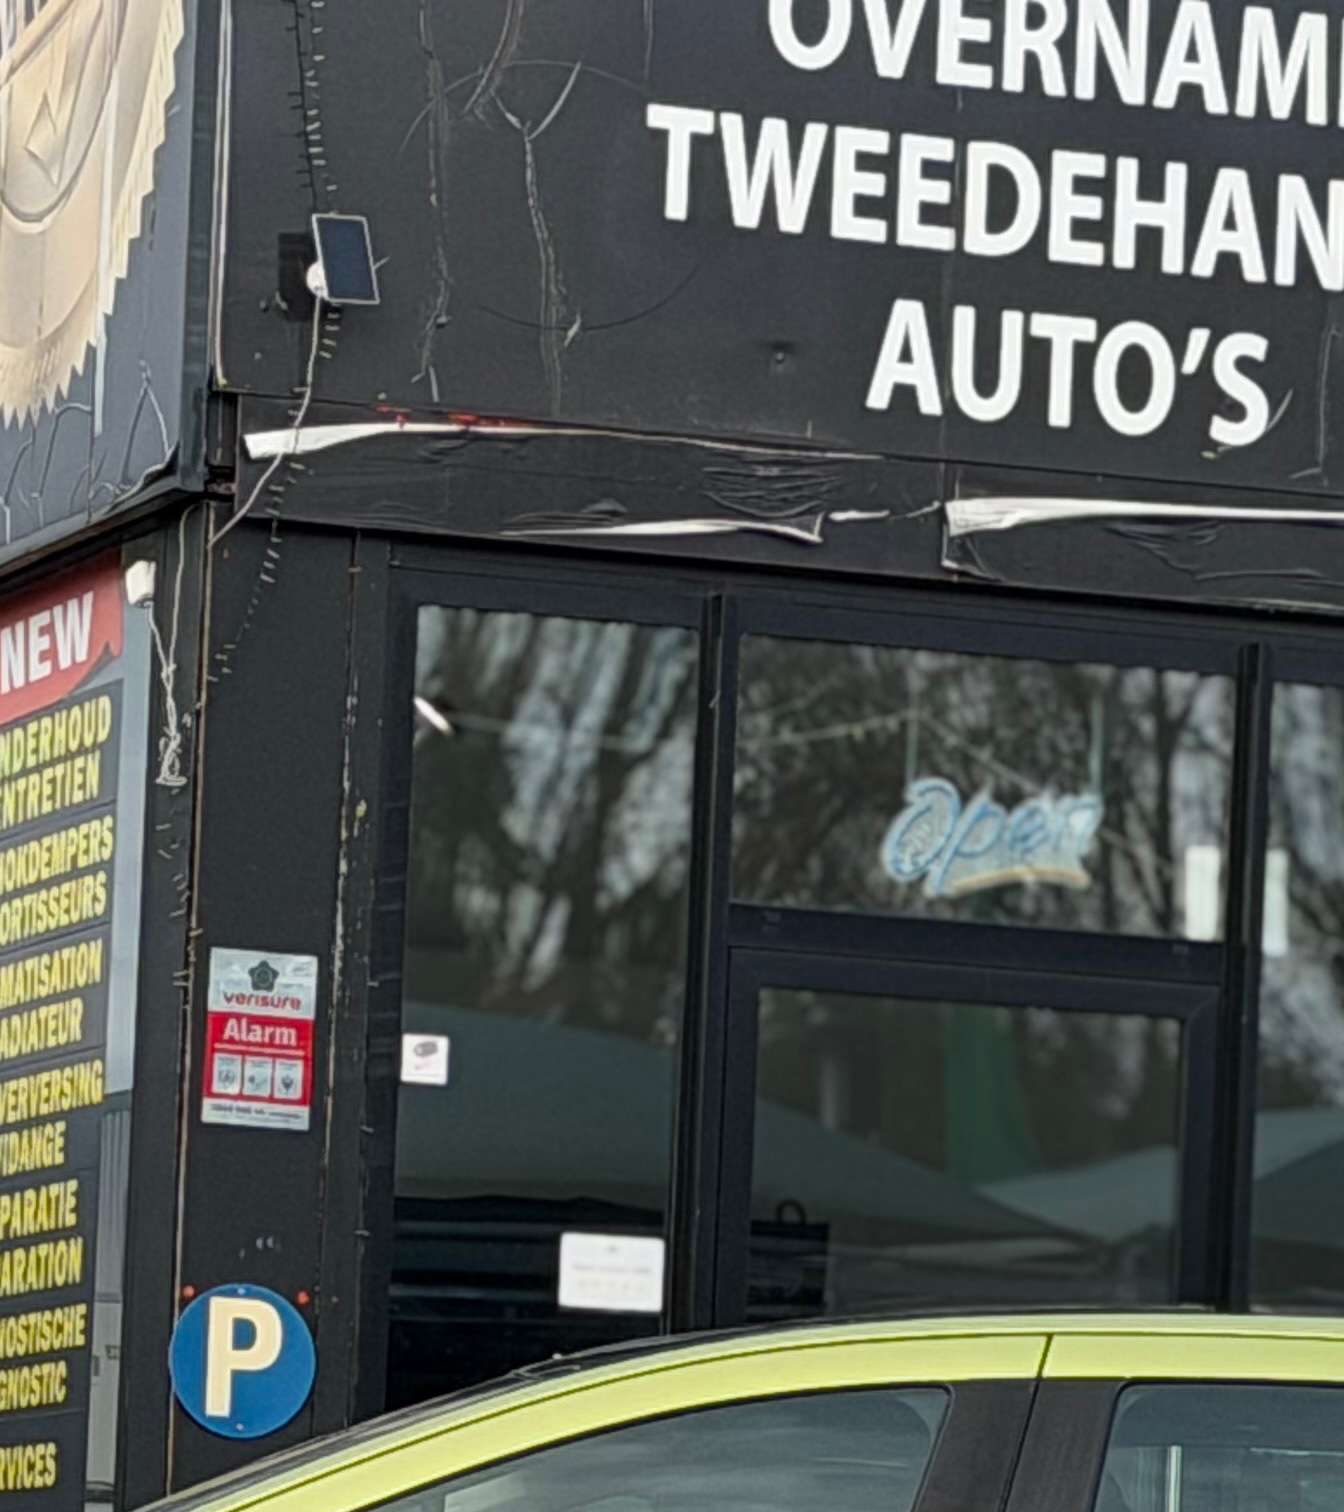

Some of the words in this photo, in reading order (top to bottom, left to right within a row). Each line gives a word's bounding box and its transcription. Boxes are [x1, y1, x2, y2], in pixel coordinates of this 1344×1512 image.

[0, 591, 94, 695] NEW
[223, 991, 302, 1011] verisure
[223, 1017, 298, 1047] Alarm
[205, 1296, 283, 1418] P
